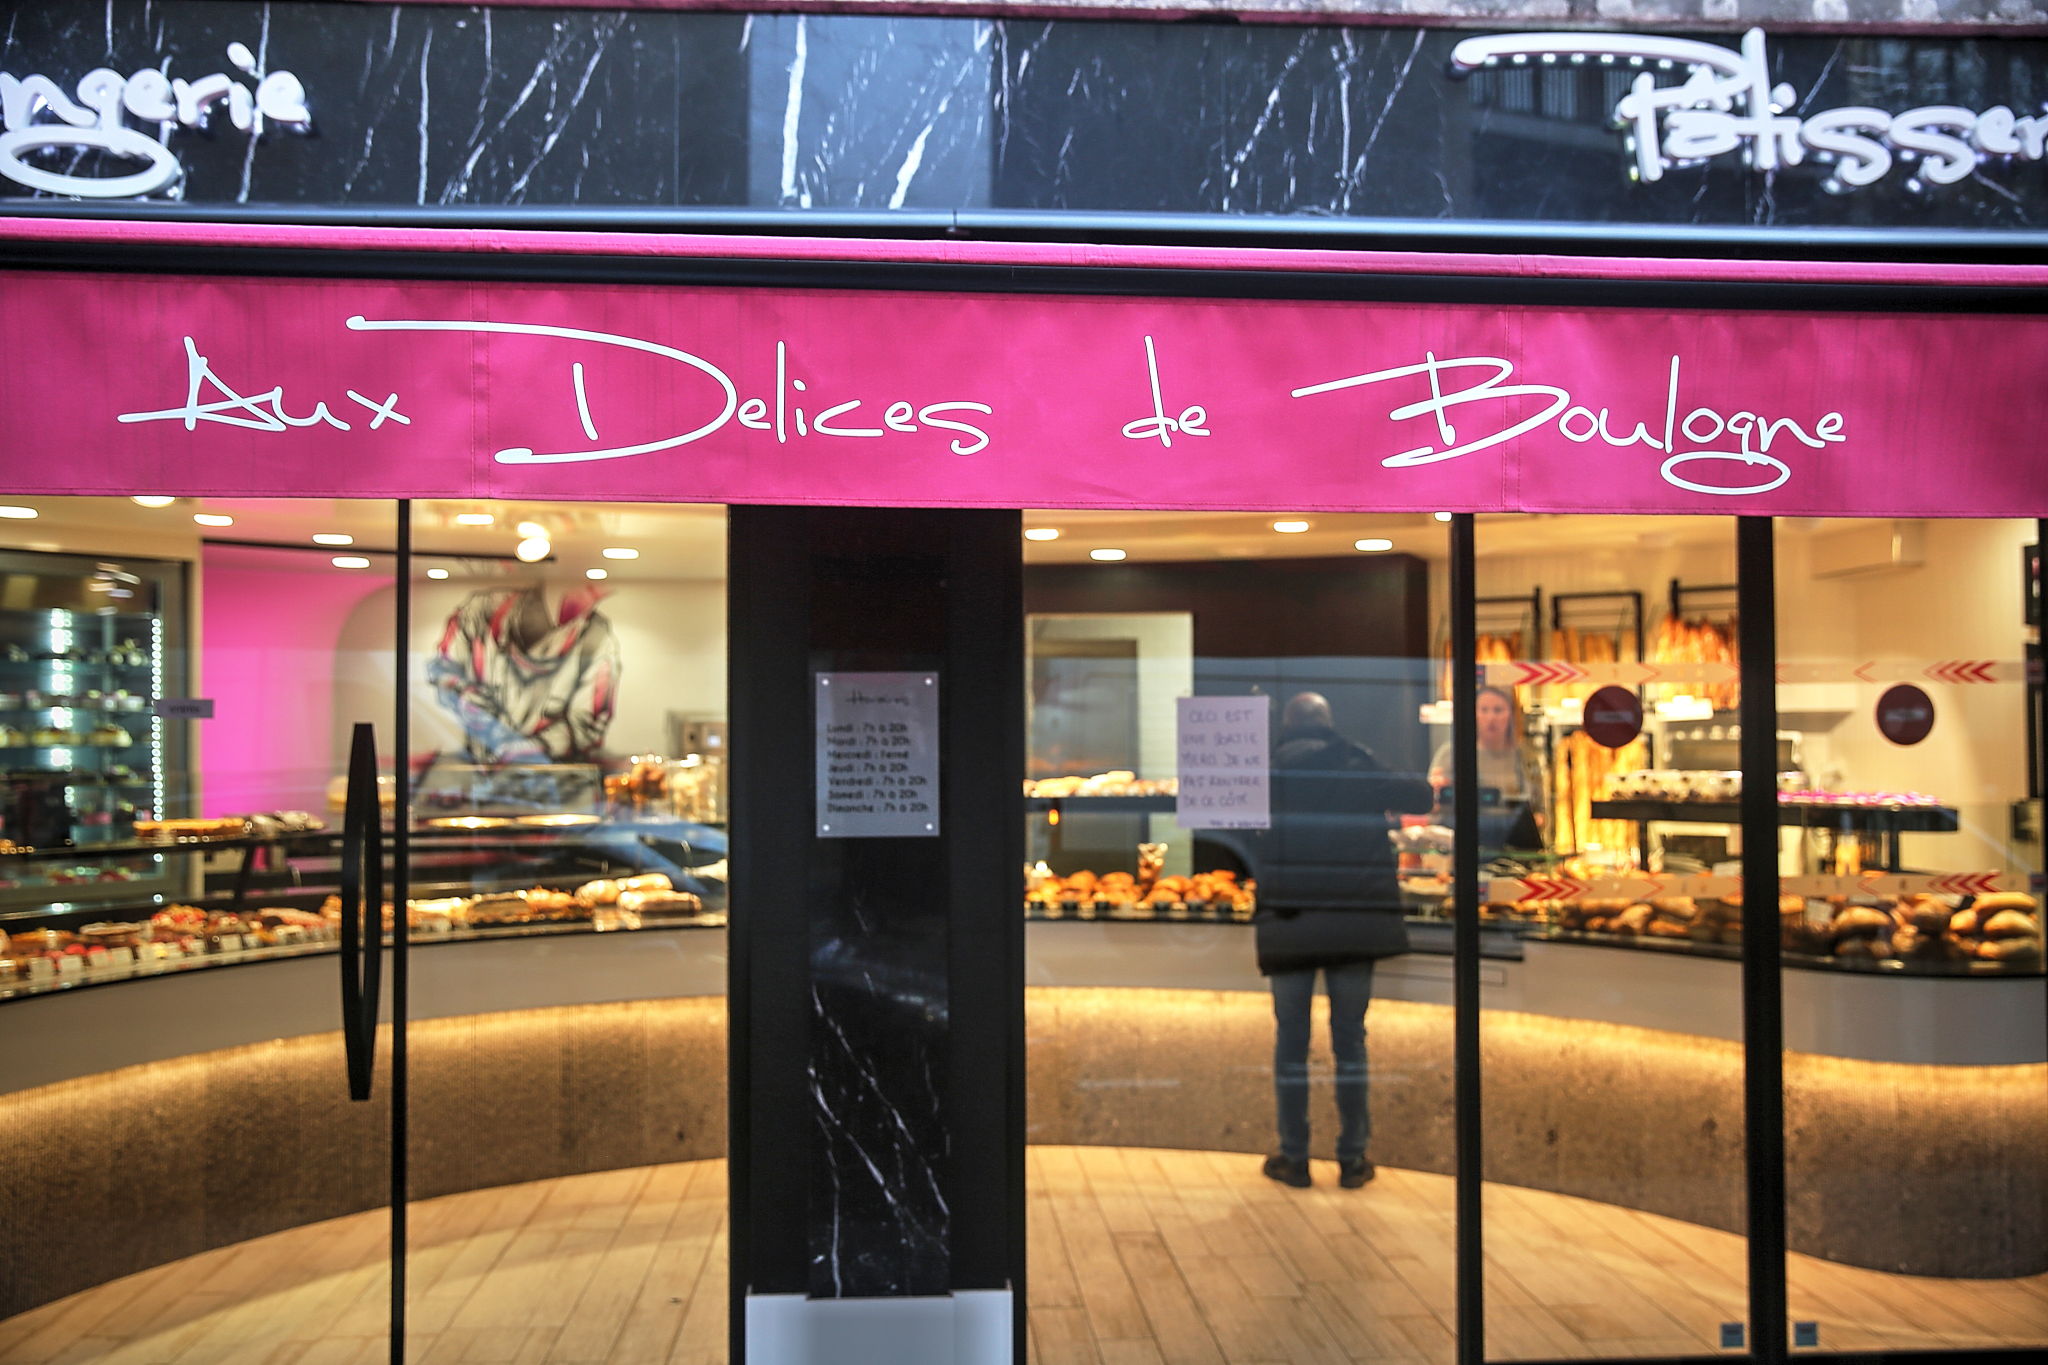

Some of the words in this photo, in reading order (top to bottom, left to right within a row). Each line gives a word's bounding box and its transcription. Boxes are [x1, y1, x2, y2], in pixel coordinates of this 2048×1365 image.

[118, 335, 411, 432] Aux
[345, 315, 993, 465] Delices
[1121, 335, 1211, 448] de
[1291, 351, 1847, 495] Boulogne
[827, 723, 853, 734] Lundi
[827, 749, 872, 760] Mercredi
[829, 763, 854, 774] Jeudi
[828, 776, 873, 787] Vendredi
[828, 789, 863, 800] Samedi
[827, 802, 874, 813] Dimanche
